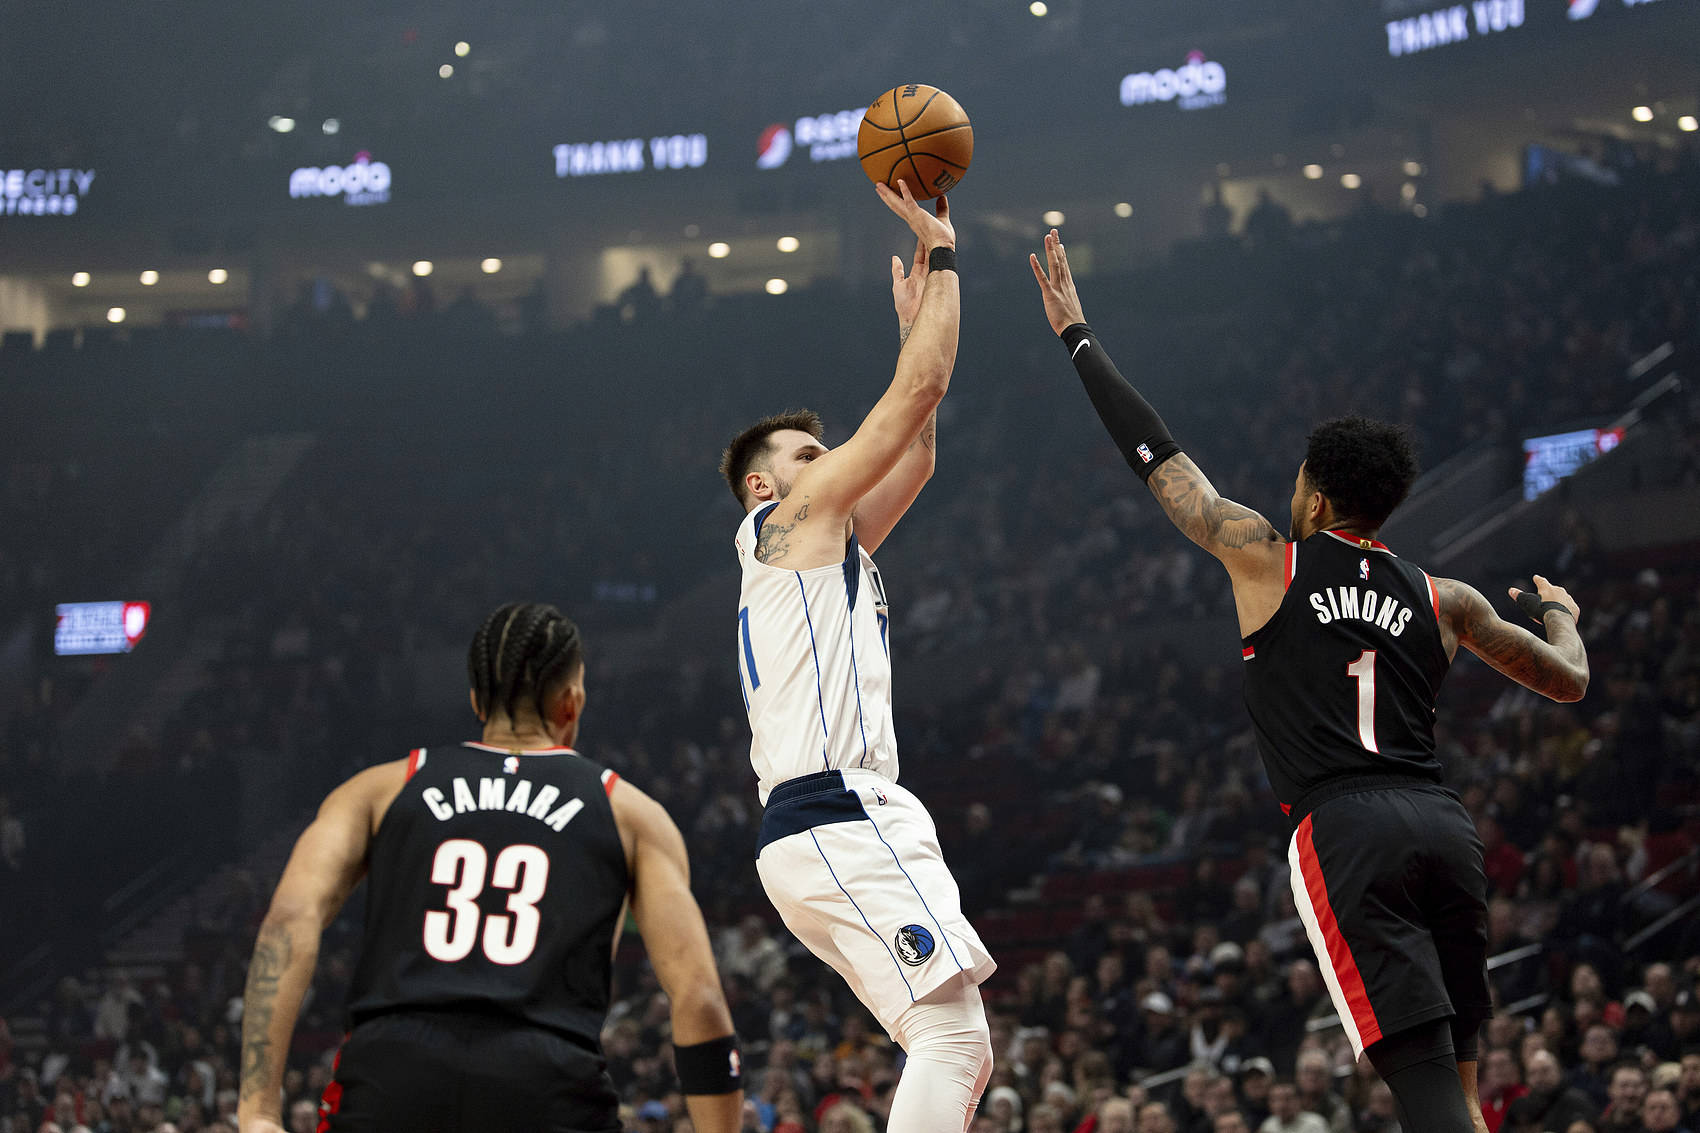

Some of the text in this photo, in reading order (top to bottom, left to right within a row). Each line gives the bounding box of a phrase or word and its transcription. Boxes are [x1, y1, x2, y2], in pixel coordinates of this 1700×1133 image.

[1385, 0, 1525, 57] THANK YOU
[1121, 50, 1226, 106] moda
[0, 168, 96, 198] ECITY
[289, 150, 391, 199] moda
[553, 133, 708, 178] THANK YOU
[1309, 586, 1413, 637] SIMONS
[1346, 649, 1380, 754] 1
[422, 777, 585, 833] CAMARA
[423, 838, 549, 966] 33
